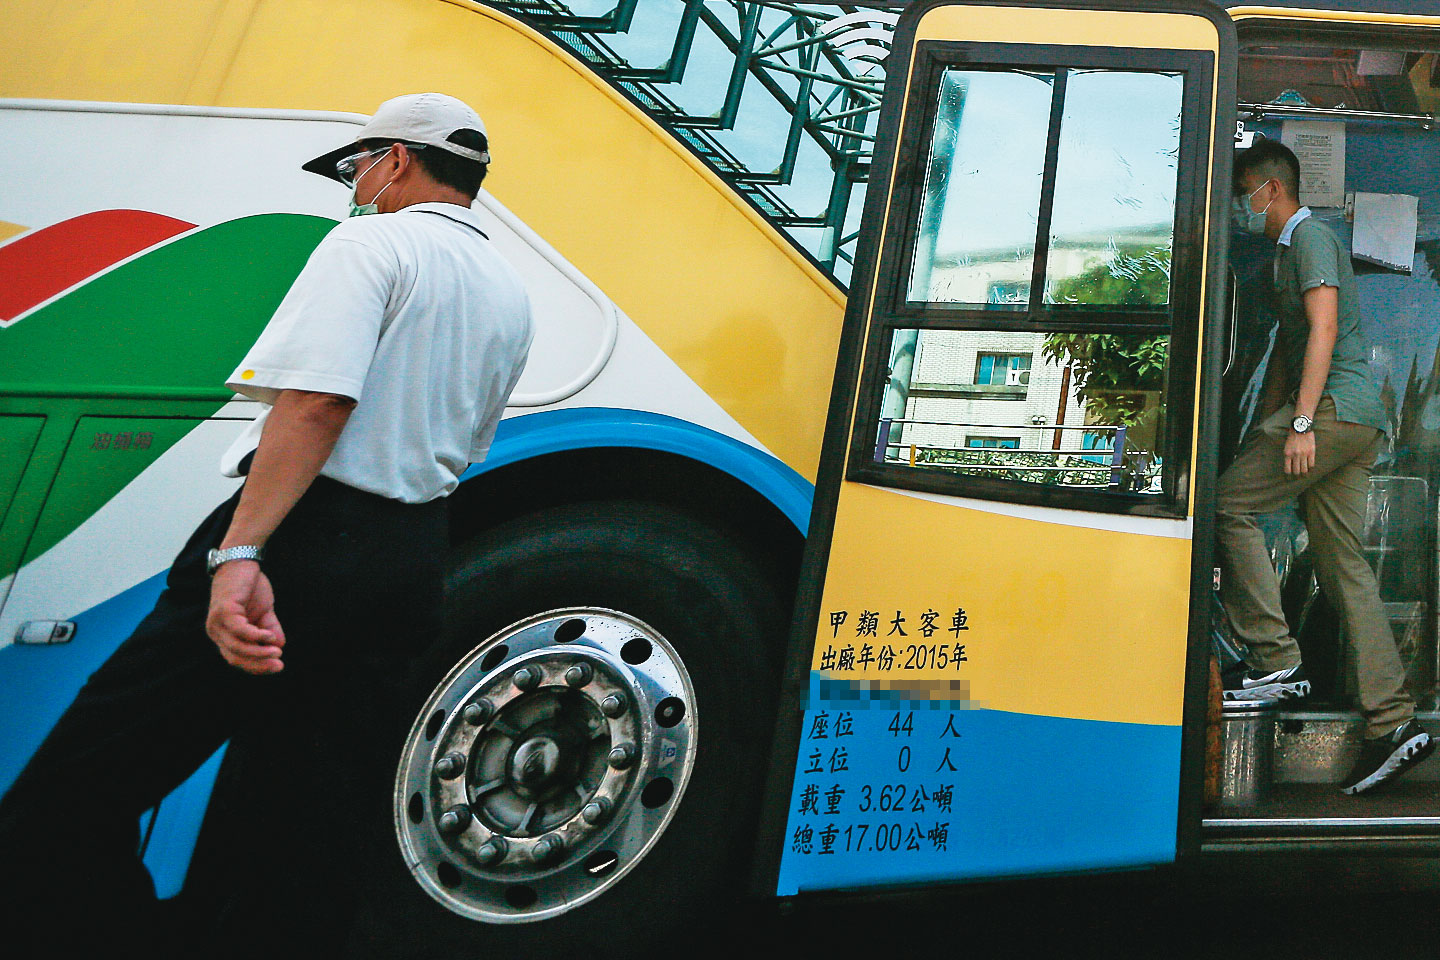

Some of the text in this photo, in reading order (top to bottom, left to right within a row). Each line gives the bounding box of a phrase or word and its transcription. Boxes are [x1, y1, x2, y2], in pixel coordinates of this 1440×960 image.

[829, 608, 969, 638] 甲類大客車
[820, 642, 968, 671] 出廠年份:2015年
[808, 710, 962, 740] 座位 44 人
[804, 746, 958, 774] 立位 0 人
[798, 784, 845, 816] 載重
